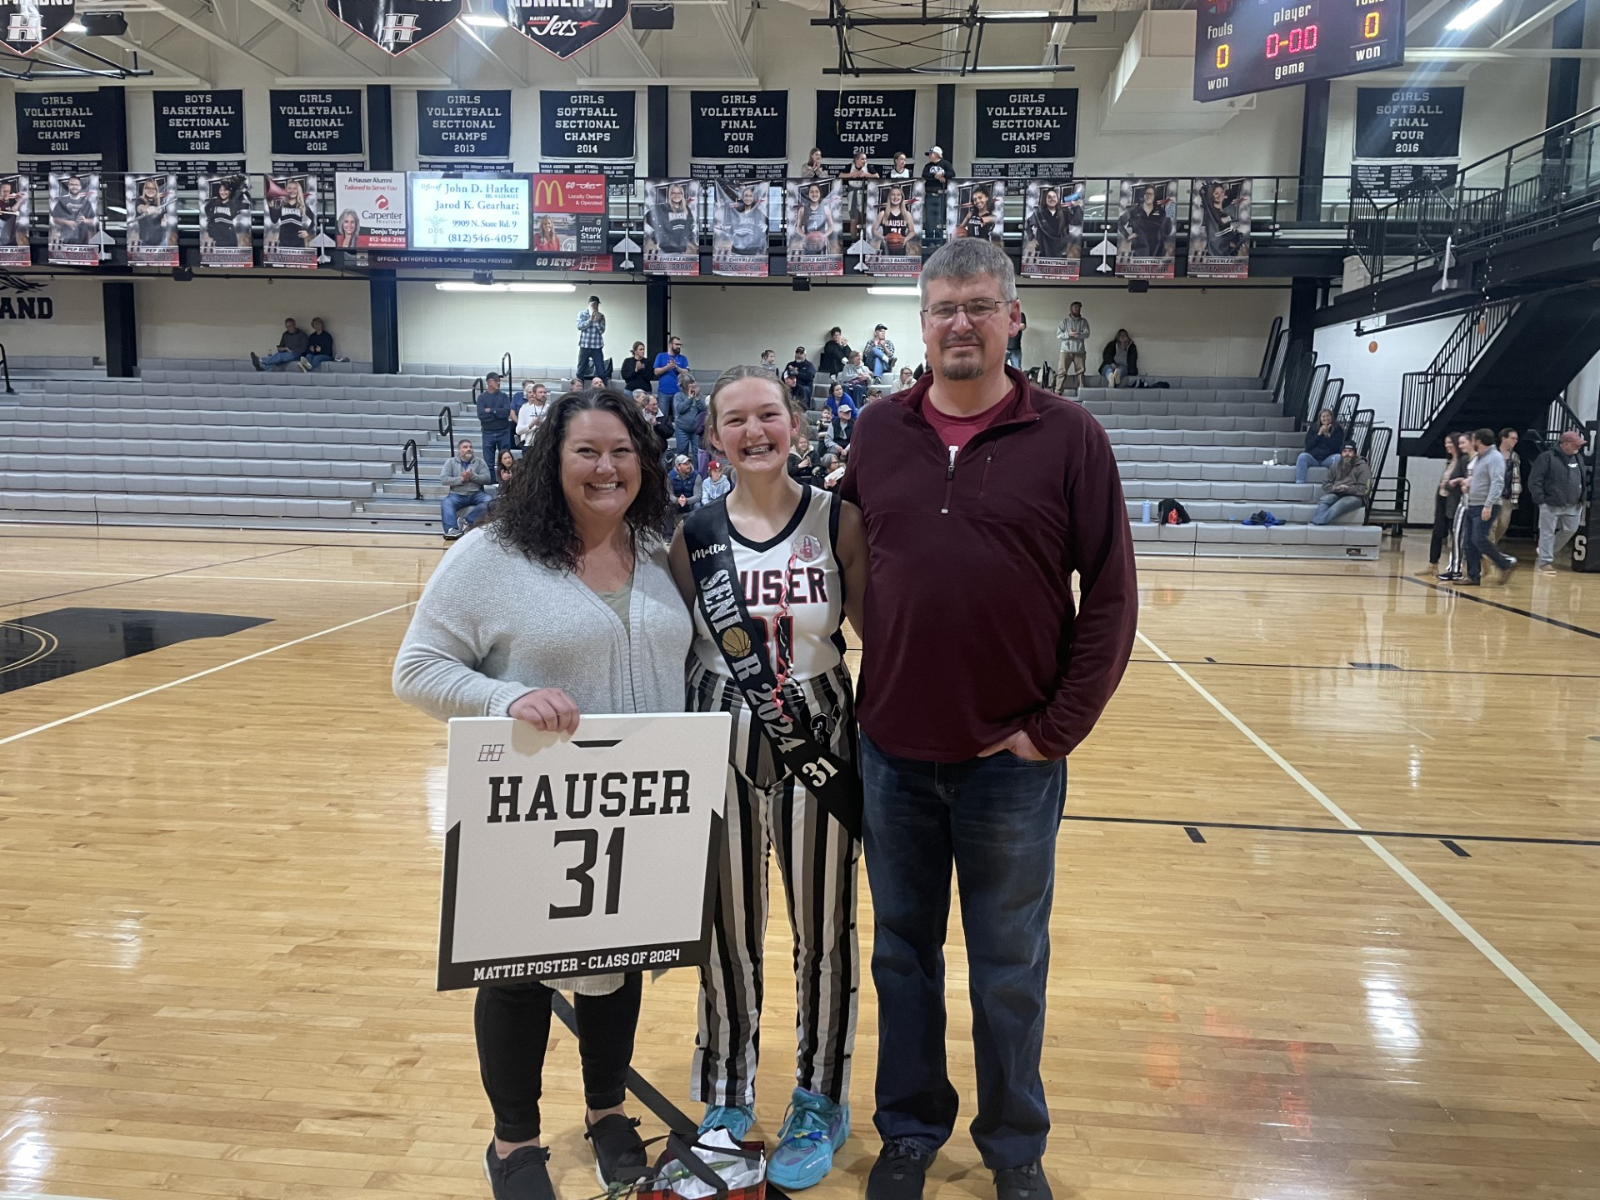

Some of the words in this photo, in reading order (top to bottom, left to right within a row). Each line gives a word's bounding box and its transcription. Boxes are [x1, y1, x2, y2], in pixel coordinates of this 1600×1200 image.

[1274, 4, 1311, 25] player
[531, 15, 578, 36] Jets
[1364, 12, 1379, 38] 0
[1207, 23, 1233, 39] fouls
[1266, 24, 1318, 58] 0-00
[1216, 44, 1230, 68] 0
[1356, 46, 1380, 61] won
[1275, 62, 1304, 79] game
[1208, 76, 1229, 90] won
[42, 97, 73, 105] GIRLS
[185, 95, 212, 103] BOYS
[300, 95, 332, 103] GIRLS
[447, 96, 480, 104] GIRLS
[570, 96, 604, 104] GIRLS
[722, 95, 756, 104] GIRLS
[848, 96, 883, 104] GIRLS
[1009, 94, 1045, 103] GIRLS
[1392, 93, 1429, 101] GIRLS
[24, 108, 93, 116] VOLLEYBALL
[162, 107, 235, 115] BASKETBALL
[280, 107, 353, 115] VOLLEYBALL
[427, 108, 502, 116] VOLLEYBALL
[557, 108, 617, 116] SOFTBALL
[700, 108, 778, 116] VOLLEYBALL
[834, 108, 896, 117] SOFTBALL
[987, 107, 1067, 116] VOLLEYBALL
[1376, 105, 1443, 114] SOFTBALL
[33, 120, 85, 128] REGIONAL
[169, 119, 229, 127] SECTIONAL
[288, 119, 344, 127] REGIONAL
[433, 120, 495, 128] SECTIONAL
[555, 120, 619, 128] SECTIONAL
[721, 120, 756, 129] FINAL
[846, 121, 884, 130] STATE
[992, 120, 1060, 128] SECTIONAL
[1390, 118, 1428, 127] FINAL
[38, 131, 80, 139] CHAMPS
[178, 130, 222, 139] CHAMPS
[294, 131, 339, 139] CHAMPS
[442, 132, 487, 141] CHAMPS
[565, 132, 610, 141] CHAMPS
[724, 133, 754, 141] FOUR
[840, 134, 889, 142] CHAMPS
[1002, 132, 1050, 141] CHAMPS
[1392, 131, 1424, 140] FOUR
[51, 143, 69, 151] 2011
[190, 142, 210, 150] 2012
[307, 143, 327, 151] 2012
[454, 145, 475, 153] 2013
[577, 145, 598, 153] 2014
[728, 145, 749, 154] 2014
[853, 146, 875, 155] 2015
[1014, 145, 1036, 154] 2015
[1396, 144, 1419, 152] 2016
[445, 184, 467, 194] John
[471, 184, 482, 193] D.
[486, 184, 519, 193] Harker
[435, 201, 460, 211] Jarod
[464, 201, 474, 209] K.
[362, 210, 402, 223] Carpenter
[536, 258, 549, 266] GO
[550, 259, 575, 267] JETS!
[691, 544, 727, 563] Mattie
[746, 682, 806, 754] 2024
[802, 757, 838, 788] 31
[487, 770, 690, 823] HAUSER
[549, 827, 625, 920] 31
[473, 962, 525, 982] MATTIE
[527, 958, 578, 975] FOSTER
[588, 952, 629, 969] CLASS
[631, 951, 647, 966] OF
[649, 949, 680, 964] 2024
